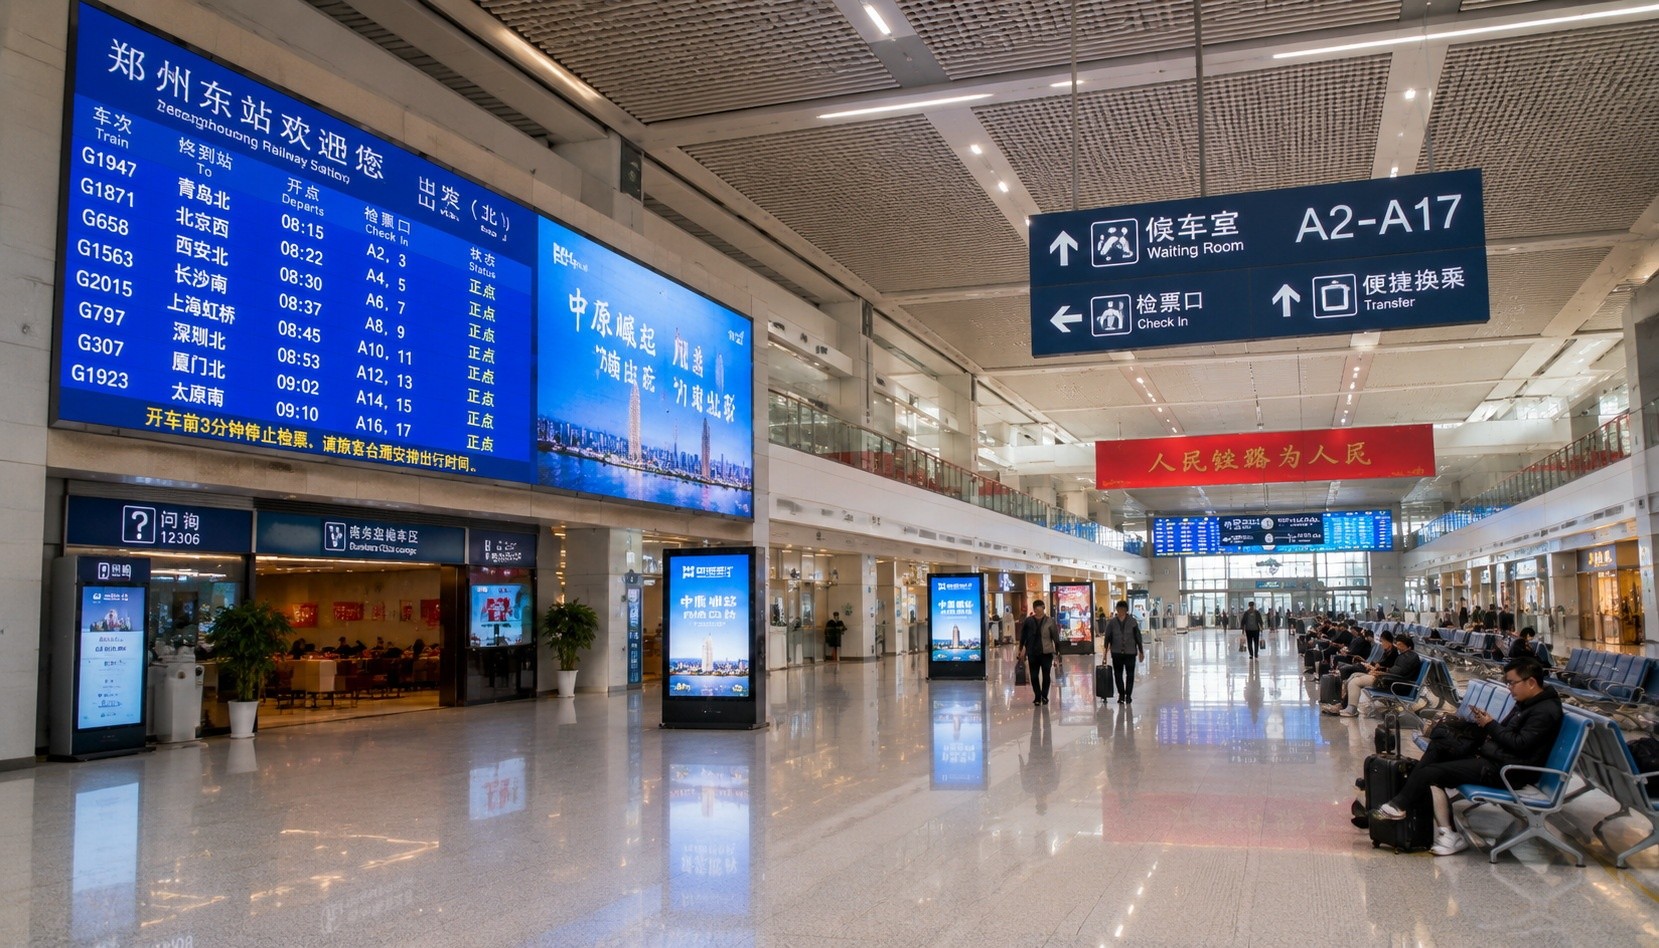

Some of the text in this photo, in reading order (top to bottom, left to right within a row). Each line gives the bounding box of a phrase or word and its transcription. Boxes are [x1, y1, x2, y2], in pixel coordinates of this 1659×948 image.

[93, 106, 132, 135] 车次
[287, 177, 320, 202] 开点
[81, 146, 137, 178] G1947
[281, 213, 325, 240] 08:15
[398, 253, 407, 268] 3
[469, 278, 496, 301] 正点
[95, 128, 496, 279] Train To Departs Check In Status
[1145, 210, 1239, 243] 候车室
[1147, 240, 1244, 259] Waiting Room
[1295, 193, 1462, 243] A2-A17
[80, 177, 134, 208] G1871
[175, 206, 230, 239] 北京西
[280, 240, 323, 266] 08:22
[398, 278, 406, 292] 5
[468, 301, 496, 323] 正点
[81, 209, 129, 236] G658
[175, 234, 230, 267] 西安北
[279, 266, 323, 292] 08:30
[397, 301, 406, 315] 7
[468, 322, 496, 344] 正点
[1362, 266, 1465, 295] 便捷换乘
[75, 269, 133, 297] G2015
[167, 292, 236, 325] 上海虹桥
[277, 320, 321, 344] 08:45
[397, 350, 413, 366] 11
[467, 365, 495, 386] 正点
[77, 239, 134, 268] G1563
[174, 263, 229, 295] 长沙南
[279, 293, 322, 317] 08:37
[397, 325, 405, 339] 9
[468, 344, 496, 365] 正点
[1136, 291, 1203, 315] 检票口
[1137, 316, 1188, 329] Check In
[1364, 297, 1416, 311] Transfer
[77, 333, 125, 357] G307
[276, 374, 320, 396] 09:02
[396, 398, 412, 413] 15
[466, 410, 495, 430] 正点
[78, 301, 126, 327] G797
[277, 347, 321, 370] 08:53
[397, 374, 413, 391] 13
[467, 388, 495, 408] 正点
[71, 364, 129, 389] G1923
[171, 381, 225, 408] 太原南
[275, 401, 319, 423] 09:10
[396, 423, 412, 438] 17
[466, 434, 494, 453] 正点
[161, 531, 200, 545] 12306
